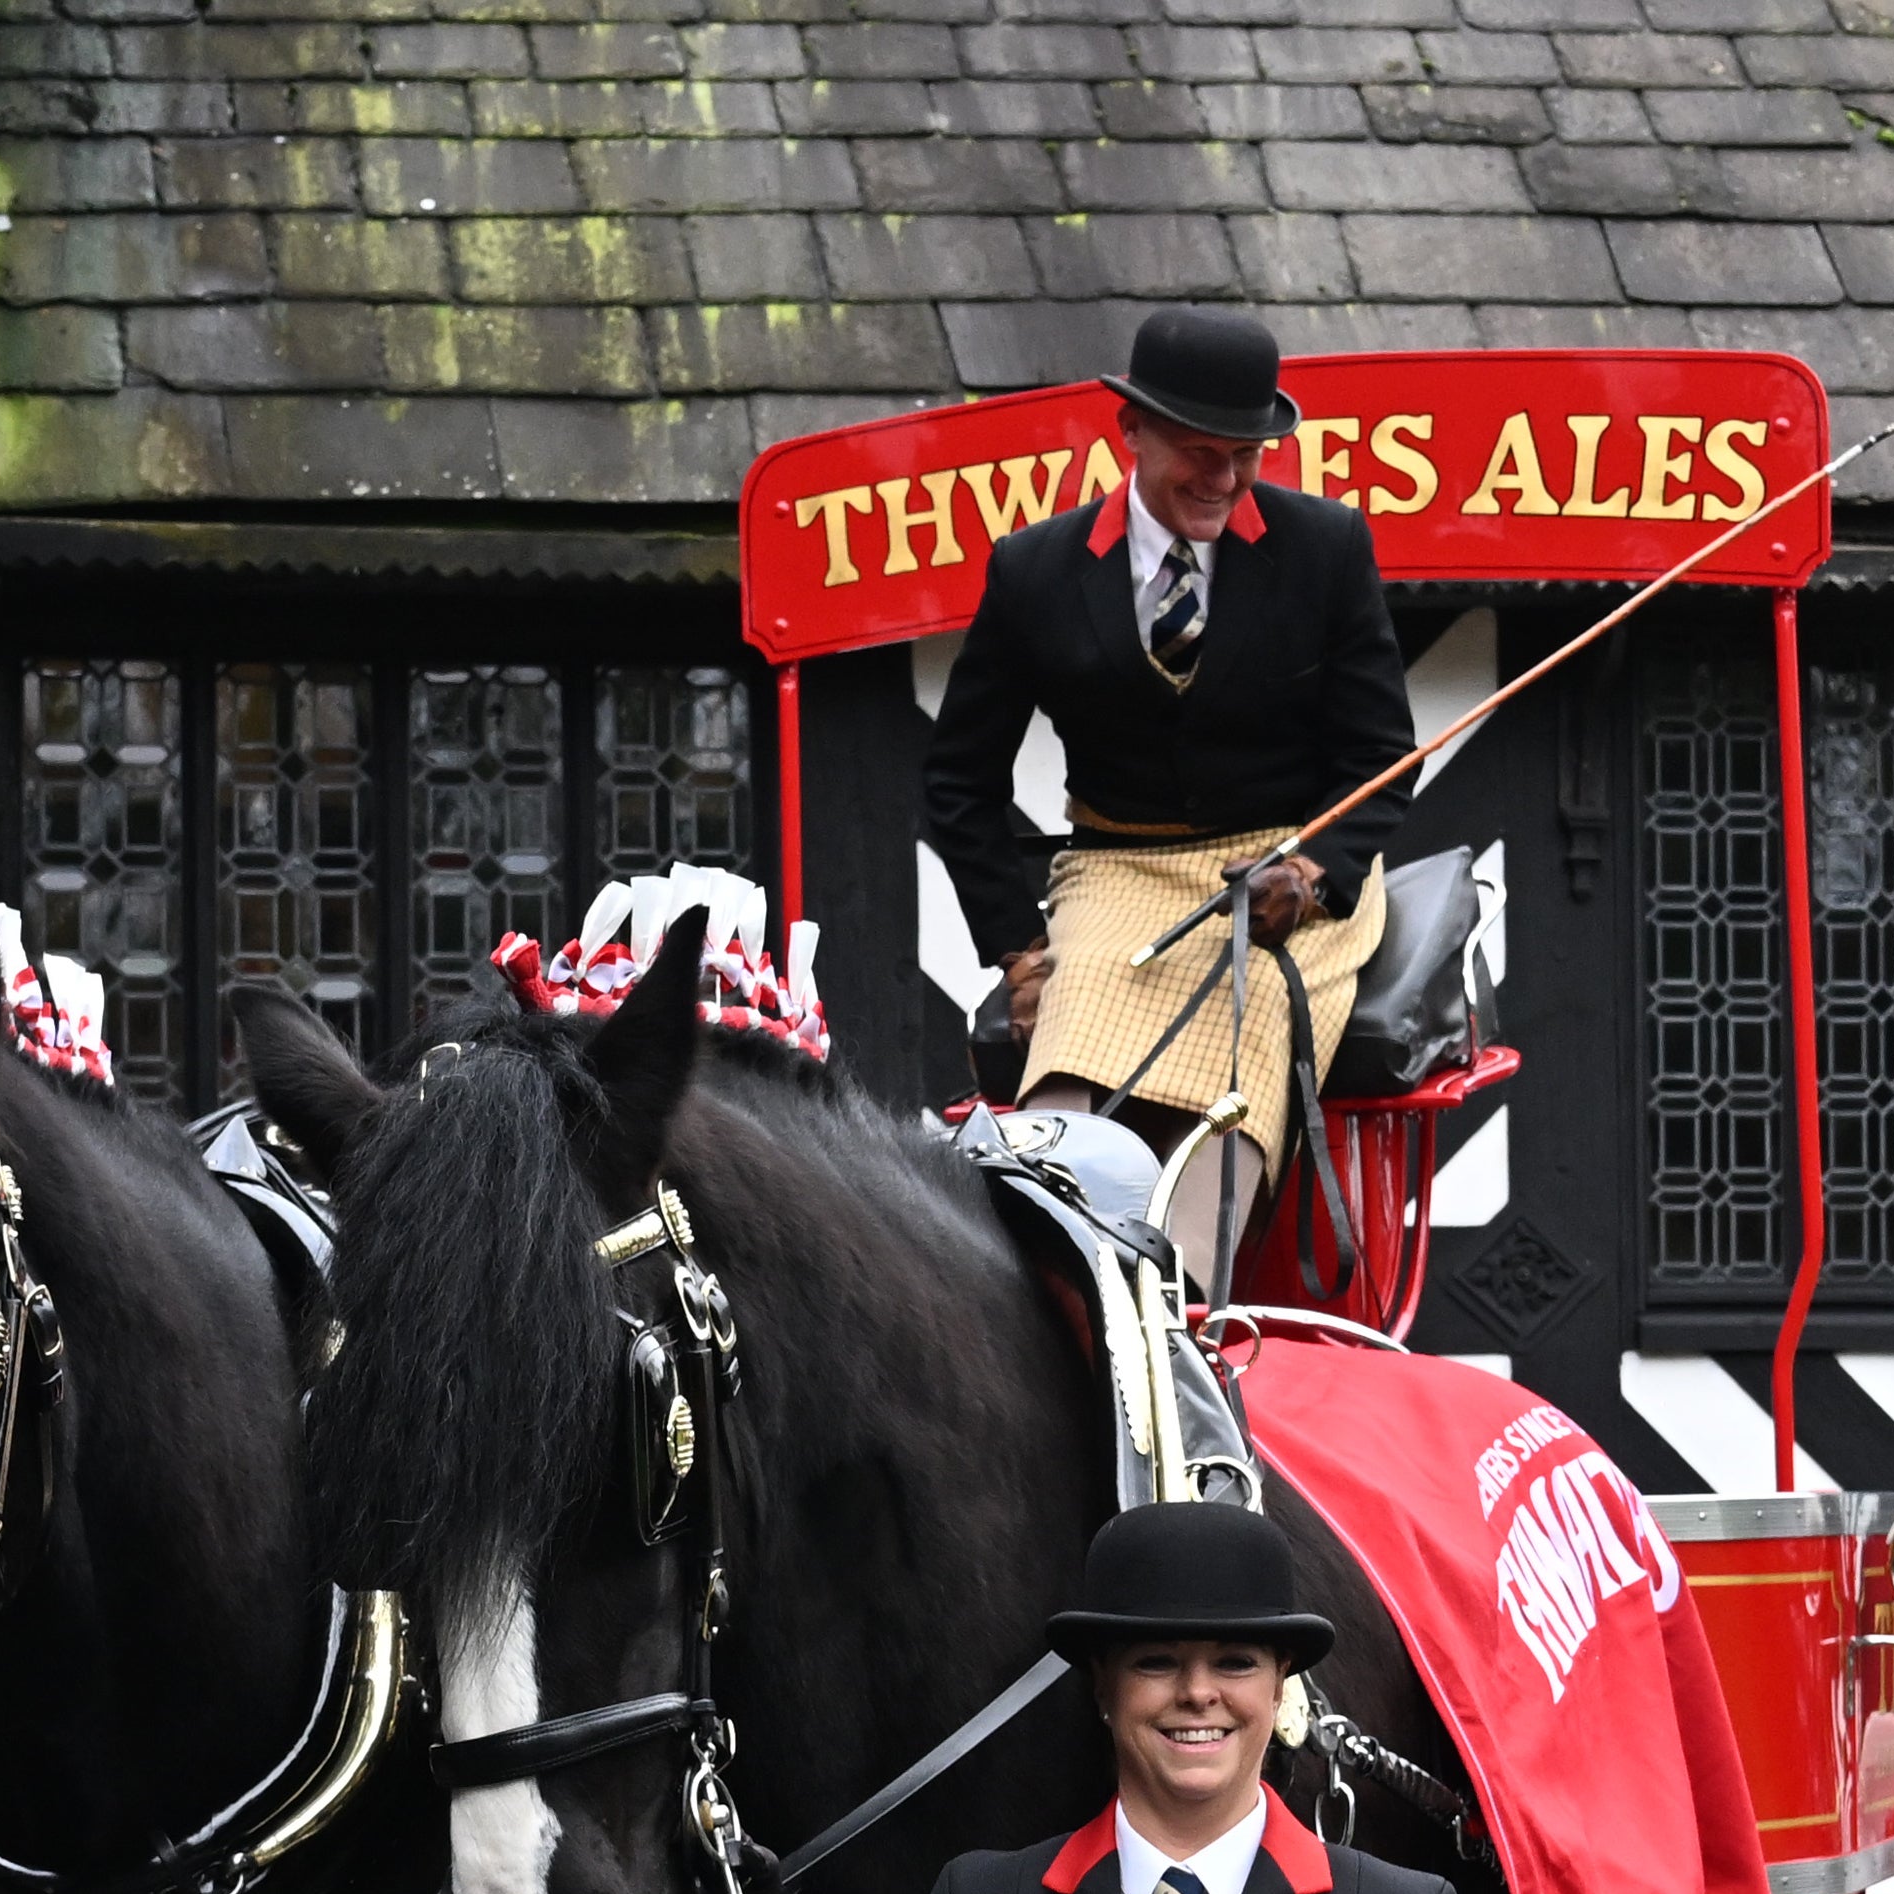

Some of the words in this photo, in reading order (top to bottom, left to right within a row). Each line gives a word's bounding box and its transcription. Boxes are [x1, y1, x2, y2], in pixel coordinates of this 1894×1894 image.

[795, 413, 1439, 588] THWAES
[1460, 409, 1769, 523] ALES
[1504, 1406, 1572, 1461] SINCE
